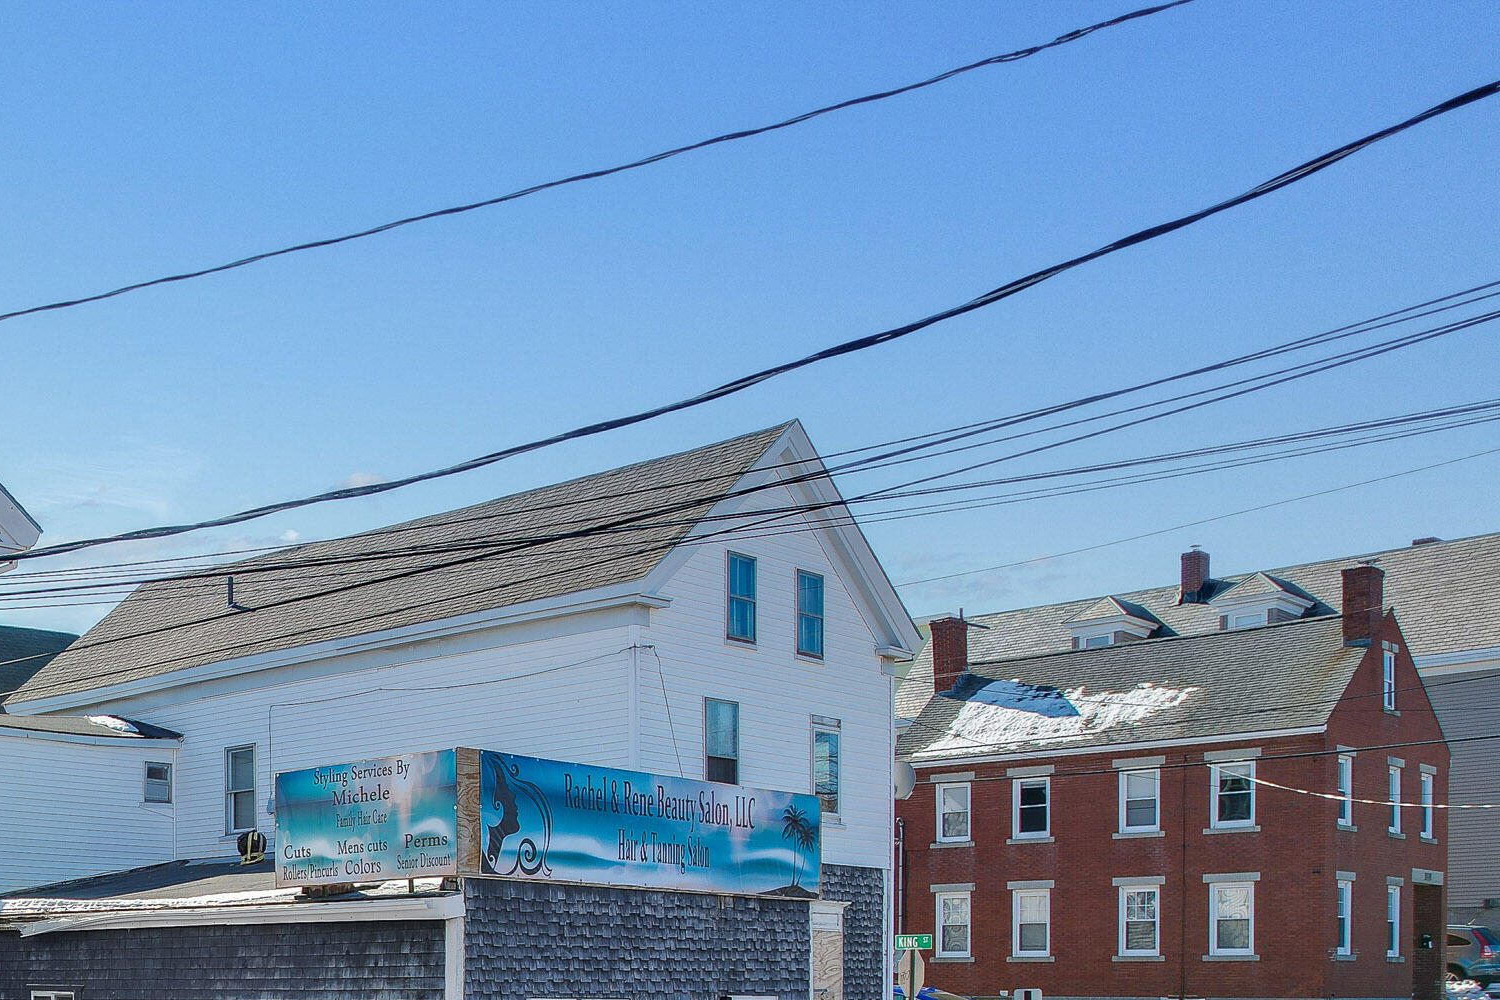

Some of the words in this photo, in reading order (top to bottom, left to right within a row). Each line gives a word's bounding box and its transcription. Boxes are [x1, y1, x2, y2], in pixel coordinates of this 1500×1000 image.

[313, 769, 348, 789] Styling
[351, 765, 393, 781] Services
[396, 759, 411, 780] By
[332, 783, 390, 807] Michele
[564, 773, 608, 812] Rachel
[611, 779, 620, 815] &
[623, 780, 654, 817] Rene
[657, 785, 697, 832] Beauty
[699, 790, 733, 833] Salon,
[735, 795, 756, 829] LLC
[336, 813, 356, 832] Family
[357, 810, 372, 826] Hair
[372, 808, 388, 825] Care
[337, 840, 365, 856] Mens
[367, 839, 388, 852] cuts
[404, 833, 448, 849] Perms
[284, 845, 312, 860] Cuts
[397, 854, 418, 871] Senior
[420, 852, 451, 868] Discount
[618, 828, 638, 861] Hair
[640, 831, 648, 863] &
[651, 832, 686, 875] Tanning
[687, 835, 710, 869] Salon
[283, 860, 339, 881] Rollers/Pincurls
[345, 859, 382, 876] Colors
[898, 936, 918, 948] KING
